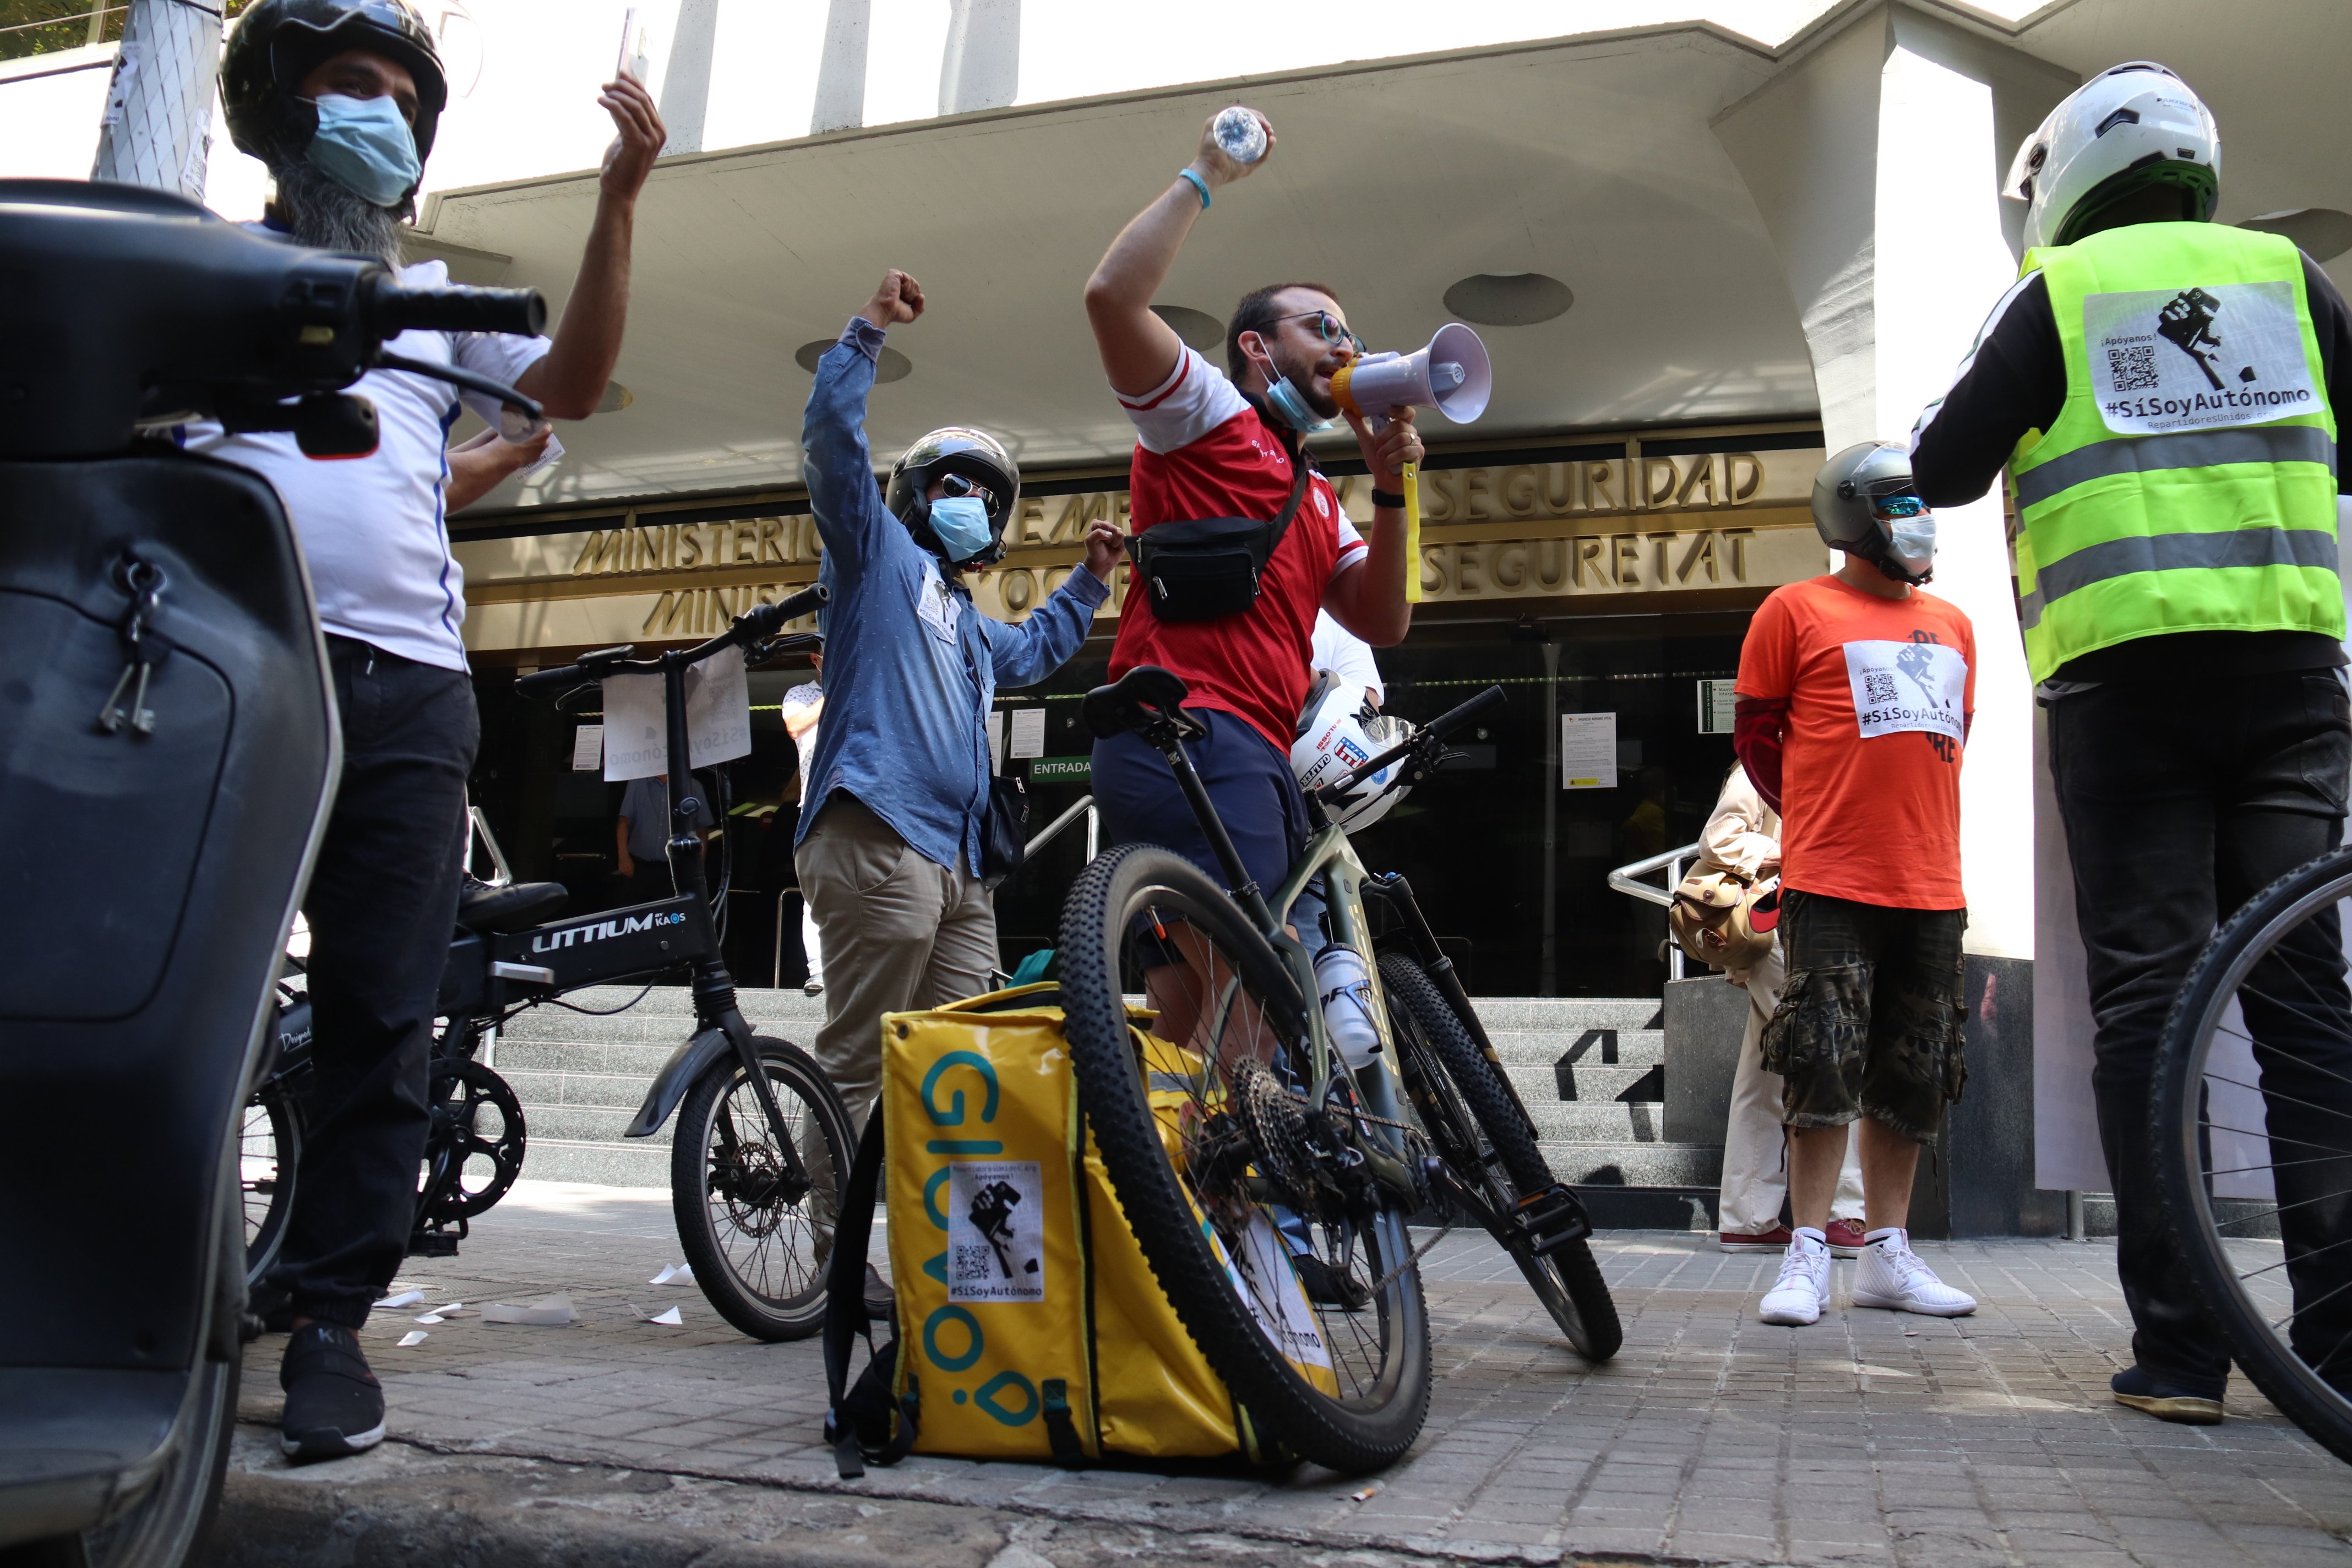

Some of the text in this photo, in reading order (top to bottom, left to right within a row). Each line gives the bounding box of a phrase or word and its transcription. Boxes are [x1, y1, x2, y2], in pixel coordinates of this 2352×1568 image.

[2100, 333, 2157, 347] ¡Apóyanos!
[2105, 386, 2311, 418] #SíSoyAutónomo
[2148, 411, 2274, 429] RepartidoresUnidos.org
[1427, 453, 1765, 521] SEGURIDAD
[1419, 529, 1756, 597] SEGURETAT
[1034, 761, 1092, 774] ENTRADA
[532, 912, 654, 953] LITTIUM
[655, 912, 686, 926] KAOS
